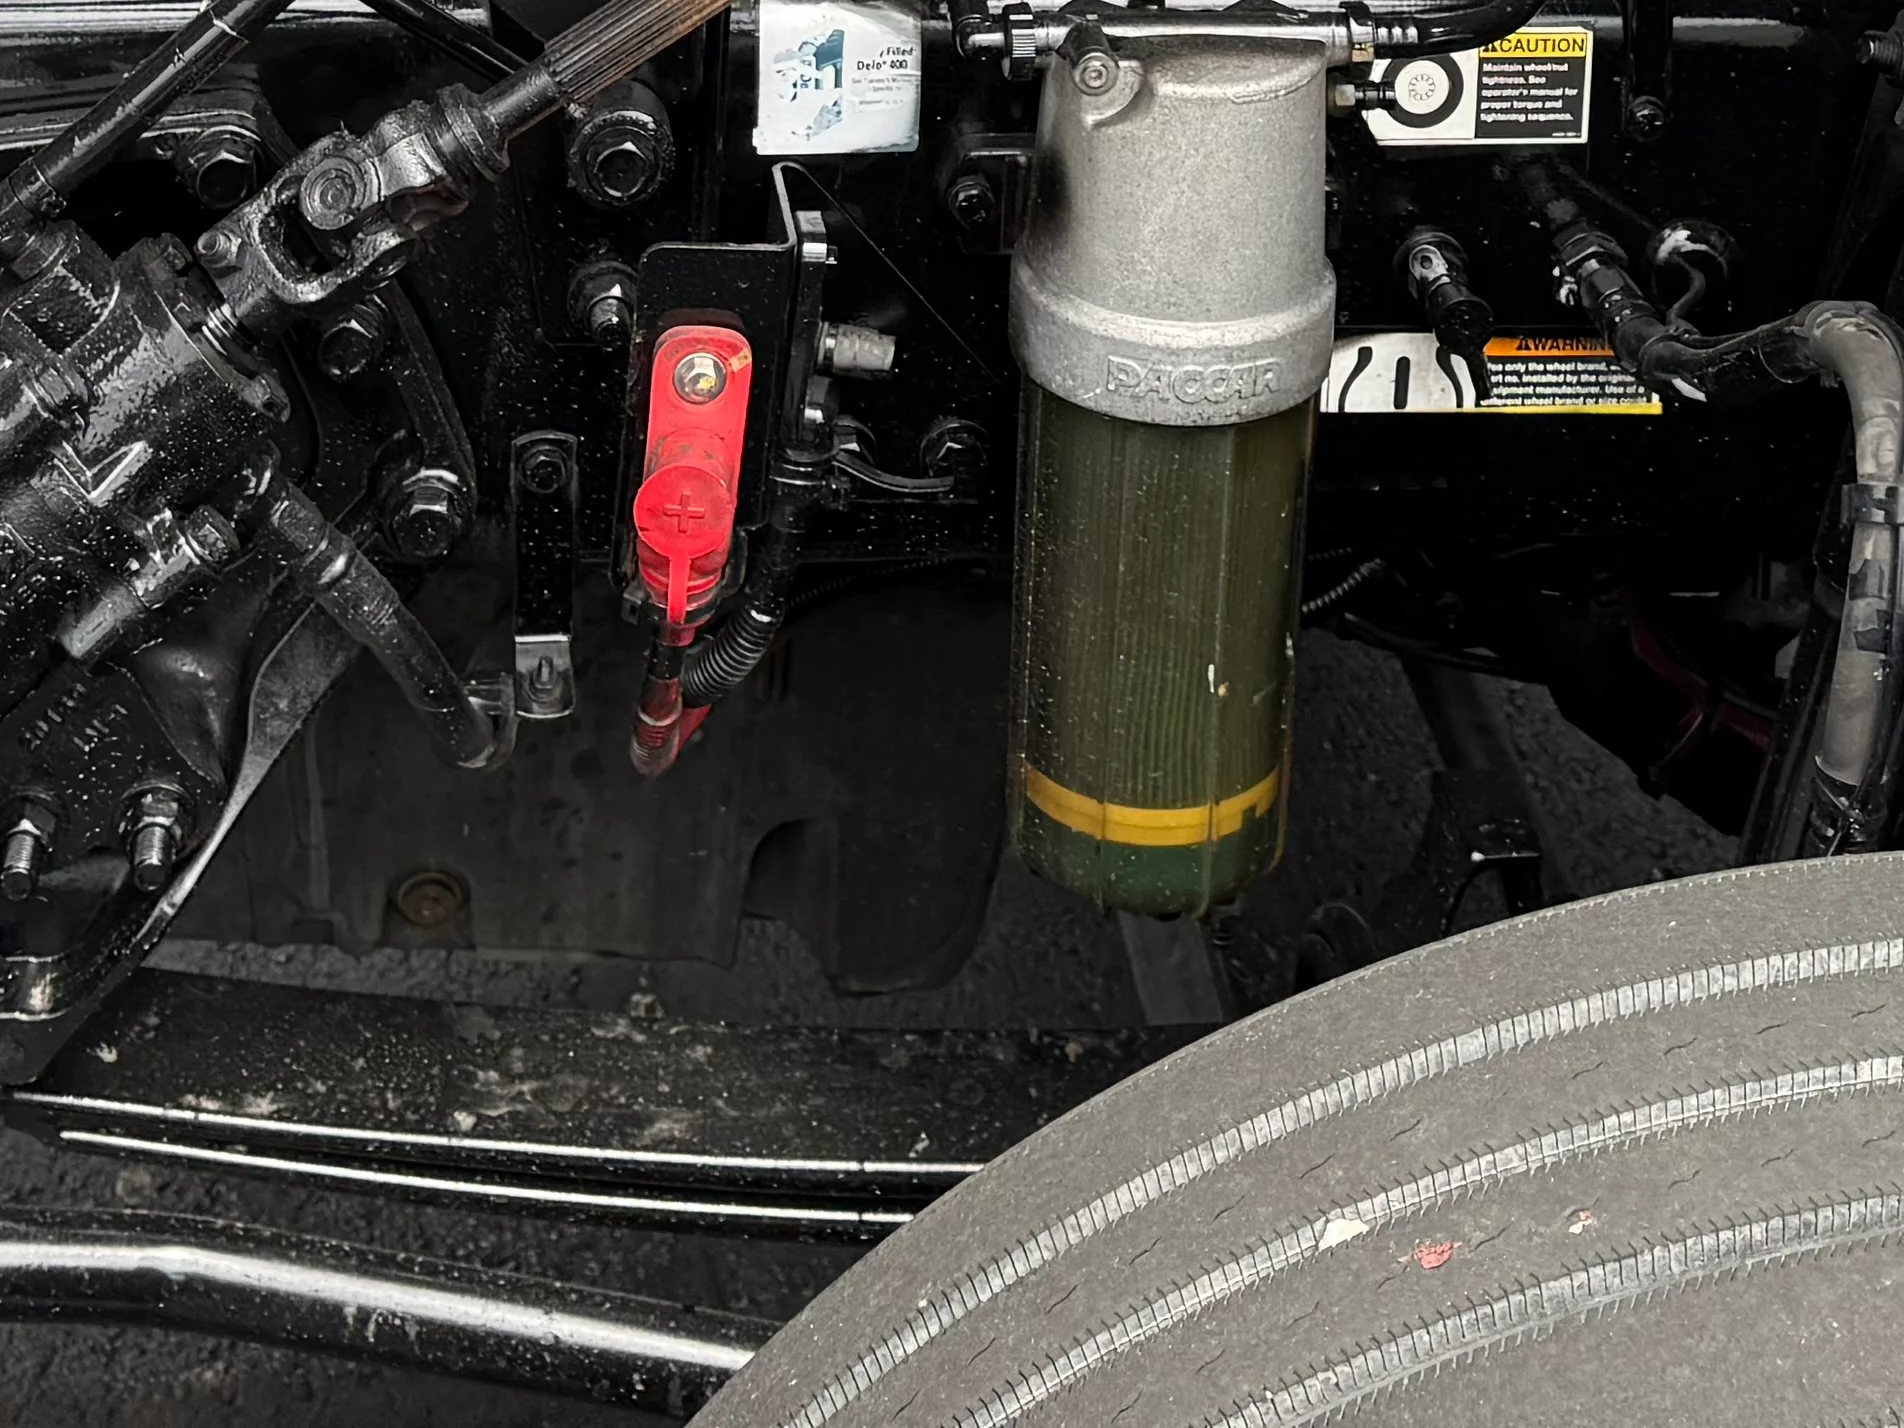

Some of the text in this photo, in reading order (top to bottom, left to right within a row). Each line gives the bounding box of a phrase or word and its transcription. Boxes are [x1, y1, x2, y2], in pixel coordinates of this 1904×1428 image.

[1499, 38, 1585, 53] CAUTION
[1533, 338, 1612, 351] WARNIN
[1528, 362, 1544, 371] the
[1546, 362, 1576, 371] wheel
[1105, 354, 1284, 406] PACCAR
